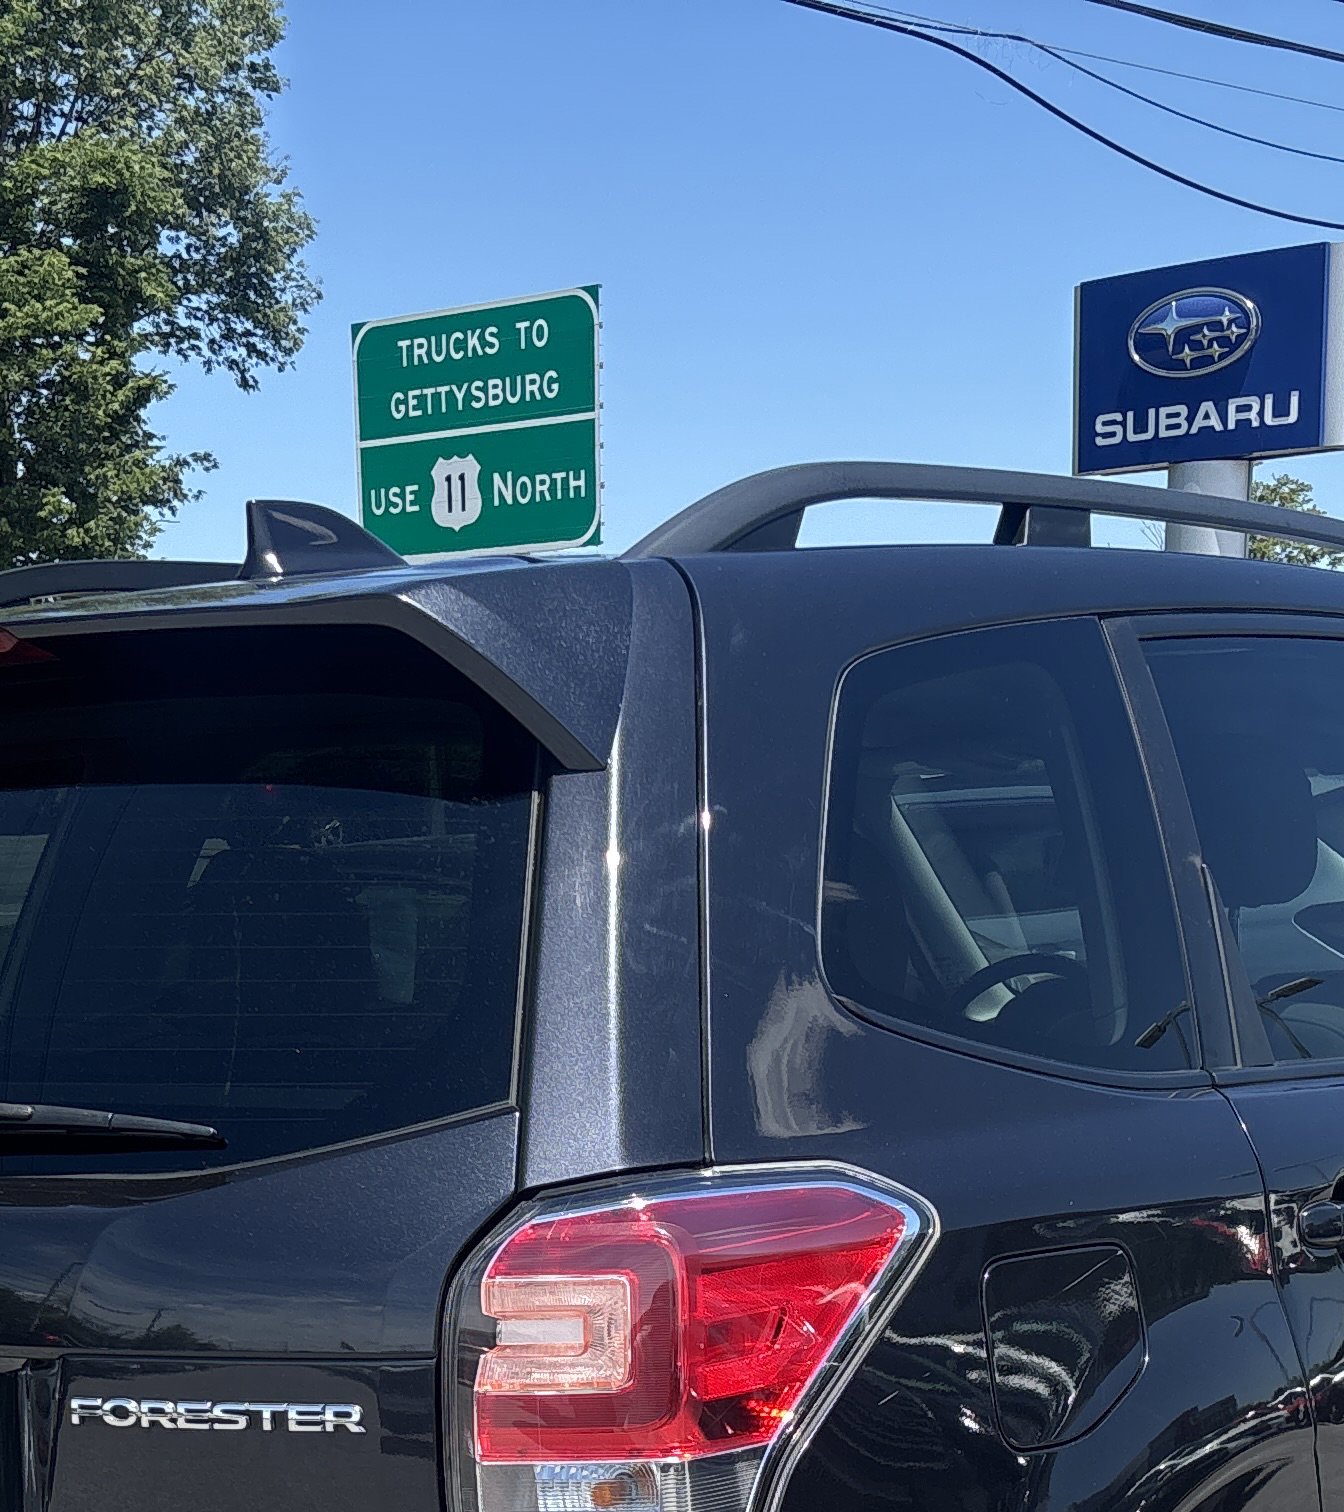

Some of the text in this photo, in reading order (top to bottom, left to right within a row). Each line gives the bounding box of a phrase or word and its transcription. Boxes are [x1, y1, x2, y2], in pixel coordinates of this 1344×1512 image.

[397, 318, 549, 368] TRUCKS TO
[390, 369, 559, 420] GETTYSBURG
[1094, 390, 1300, 447] SUBARU
[370, 468, 586, 516] USE 11 NORTH
[70, 1396, 367, 1434] FORESTER
